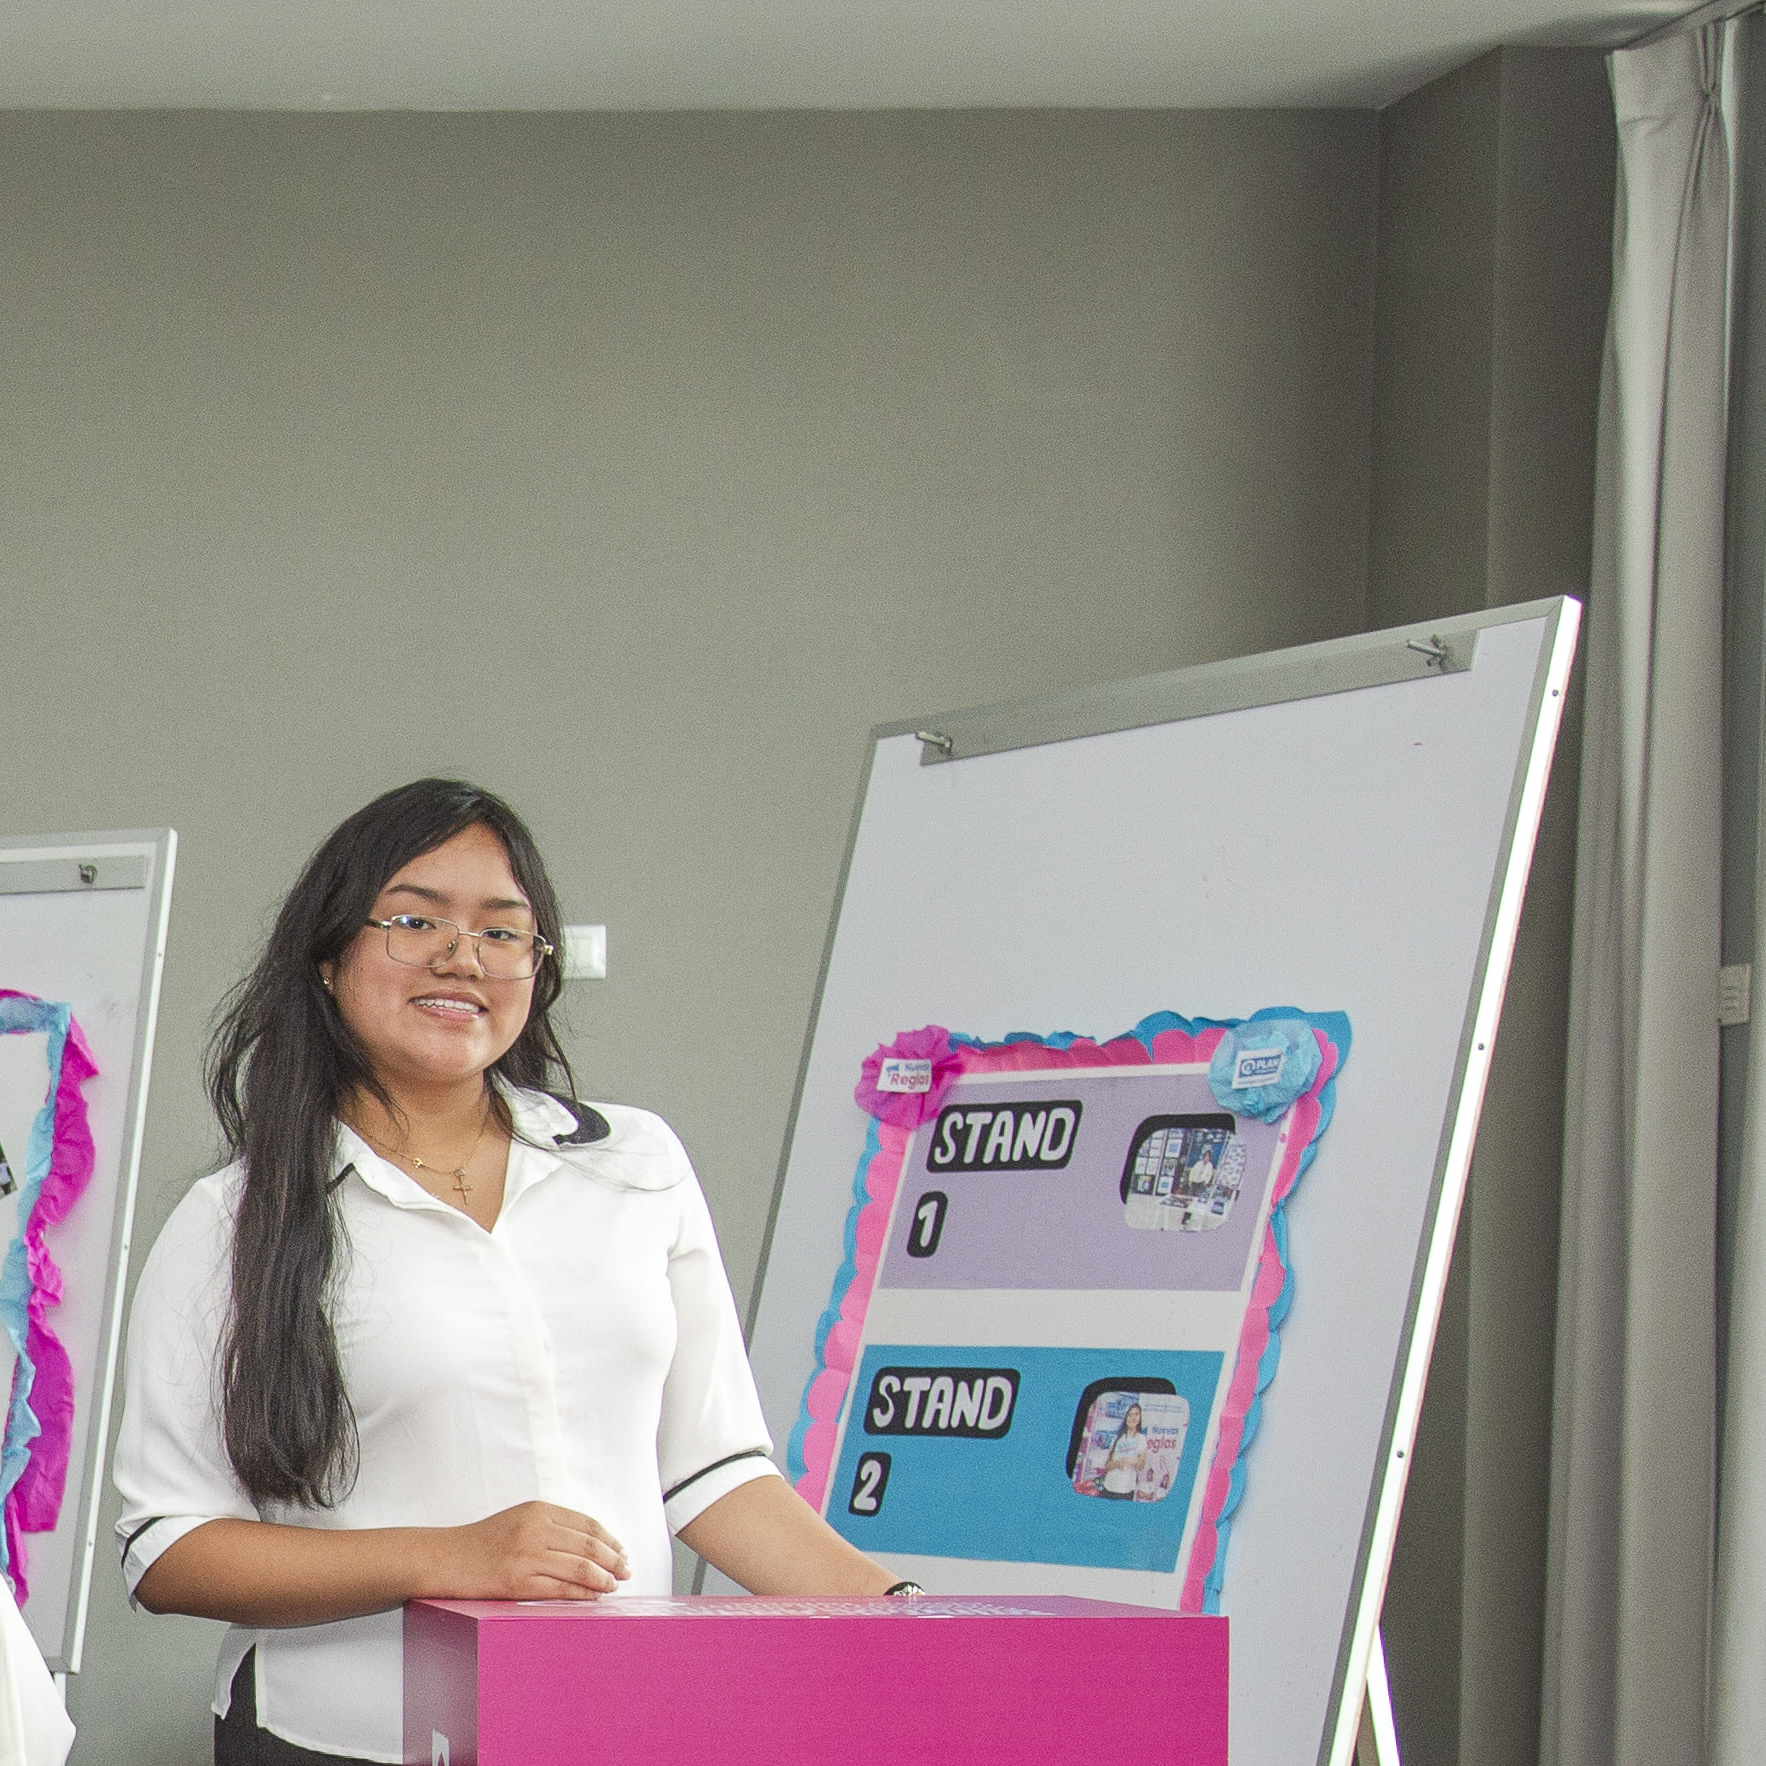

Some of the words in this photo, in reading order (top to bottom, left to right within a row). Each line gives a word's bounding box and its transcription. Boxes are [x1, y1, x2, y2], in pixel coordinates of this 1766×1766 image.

[933, 1106, 1076, 1166] STAND
[917, 1198, 939, 1248] 1
[872, 1376, 1014, 1431] STAND
[1146, 1438, 1177, 1454] eglas
[854, 1457, 882, 1511] 2
